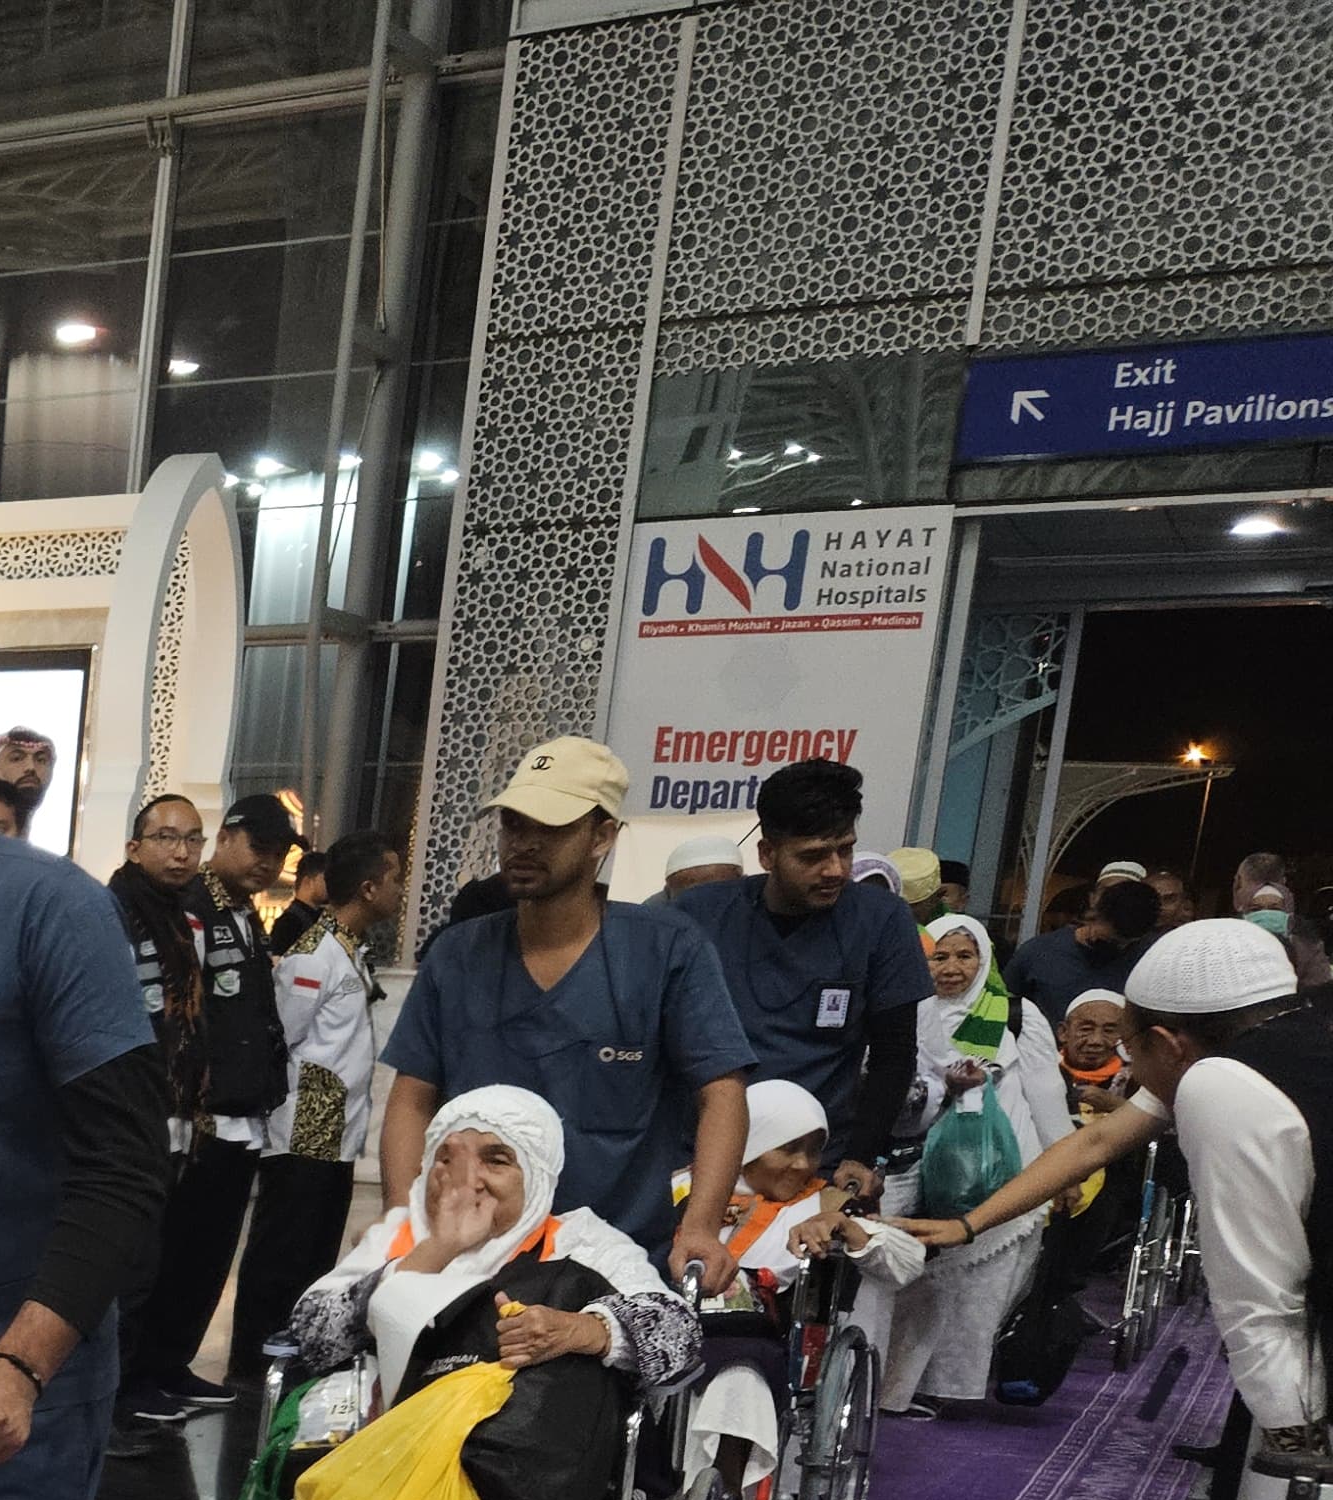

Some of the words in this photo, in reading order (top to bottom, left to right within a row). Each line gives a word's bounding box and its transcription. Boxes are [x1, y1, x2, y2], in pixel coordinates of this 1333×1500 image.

[1114, 358, 1177, 389] Exit
[1107, 401, 1175, 437] Hajj
[1183, 393, 1333, 427] Pavilions
[824, 527, 937, 551] HAYAT
[820, 556, 931, 579] National
[816, 585, 927, 608] Hospitals
[642, 623, 678, 636] Riyadh
[687, 620, 726, 633] Khamis
[728, 619, 771, 631] Mushait
[780, 618, 810, 631] Jazan
[821, 616, 862, 629] Qassim
[871, 614, 919, 627] Madinah
[653, 726, 858, 766] Emergency
[649, 775, 763, 815] Depart
